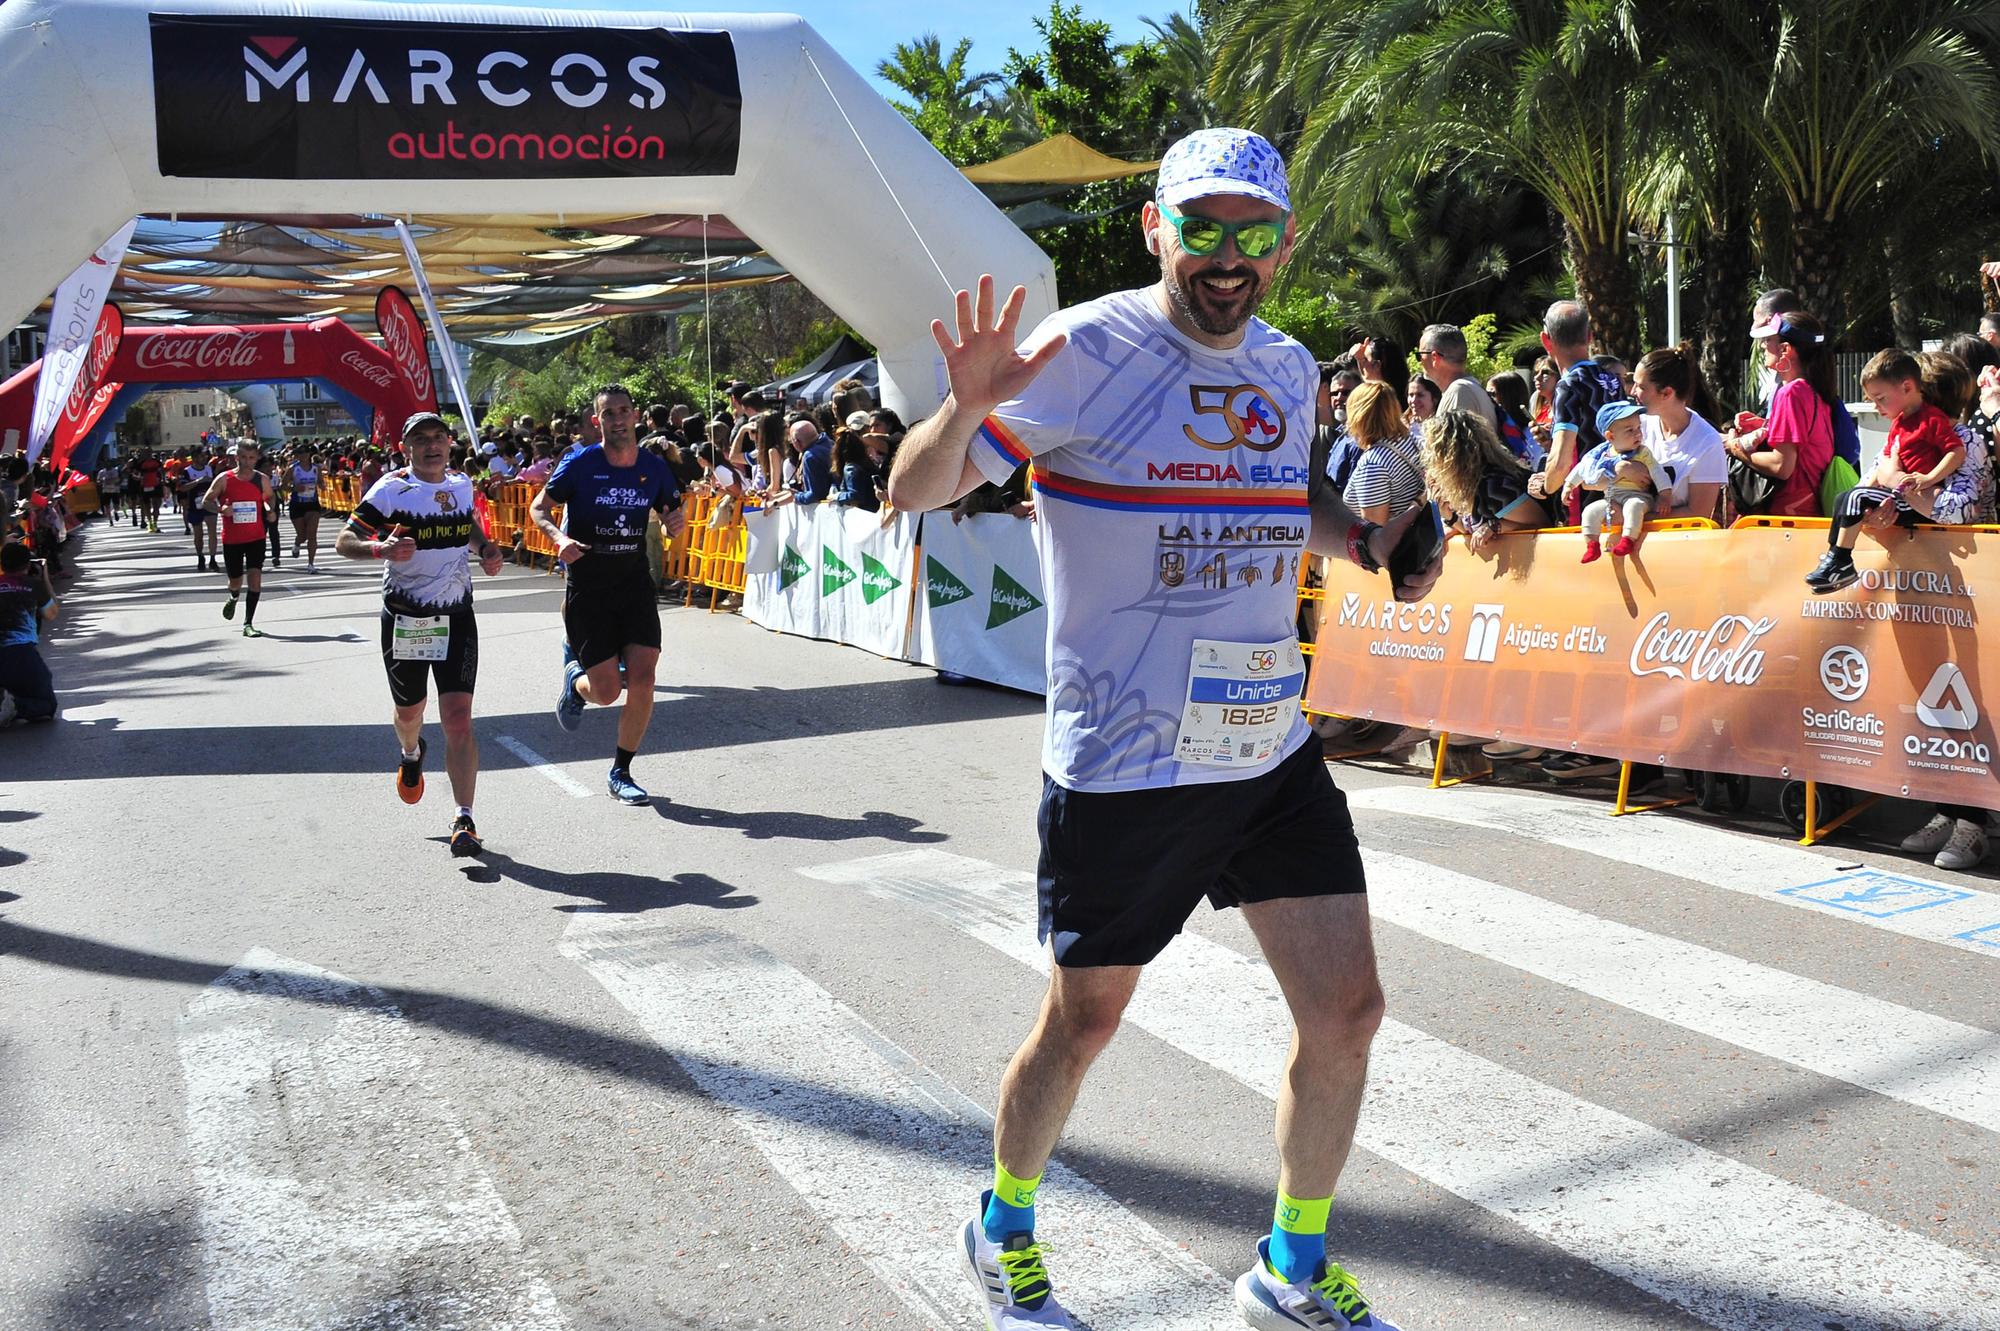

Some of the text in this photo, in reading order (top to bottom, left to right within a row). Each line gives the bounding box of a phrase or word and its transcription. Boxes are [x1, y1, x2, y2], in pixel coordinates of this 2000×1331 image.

[243, 36, 666, 110] MARCOS
[387, 120, 665, 160] automoción
[136, 331, 262, 368] Coca-Cola
[341, 351, 398, 388] Coca-Cola
[1147, 463, 1242, 482] MEDIA
[595, 496, 648, 507] PRO-TEAM
[418, 527, 433, 540] NO
[436, 525, 453, 538] PUC
[1159, 525, 1194, 541] LA
[1218, 525, 1304, 541] ANTIGUA
[1338, 592, 1453, 634] MARCOS
[1801, 600, 1975, 628] EMPRESA CONSTRUCTORA
[1369, 636, 1444, 662] automoción
[1503, 623, 1607, 655] Aigües d'Elx
[1629, 611, 1779, 686] Coca-Cola
[1247, 650, 1277, 671] 50
[1226, 682, 1282, 700] Unirbe
[1221, 706, 1278, 726] 1822
[1803, 707, 1884, 736] SeriGrafic
[1917, 760, 1939, 769] PUNTO
[1950, 764, 1987, 775] ENCUENTRO
